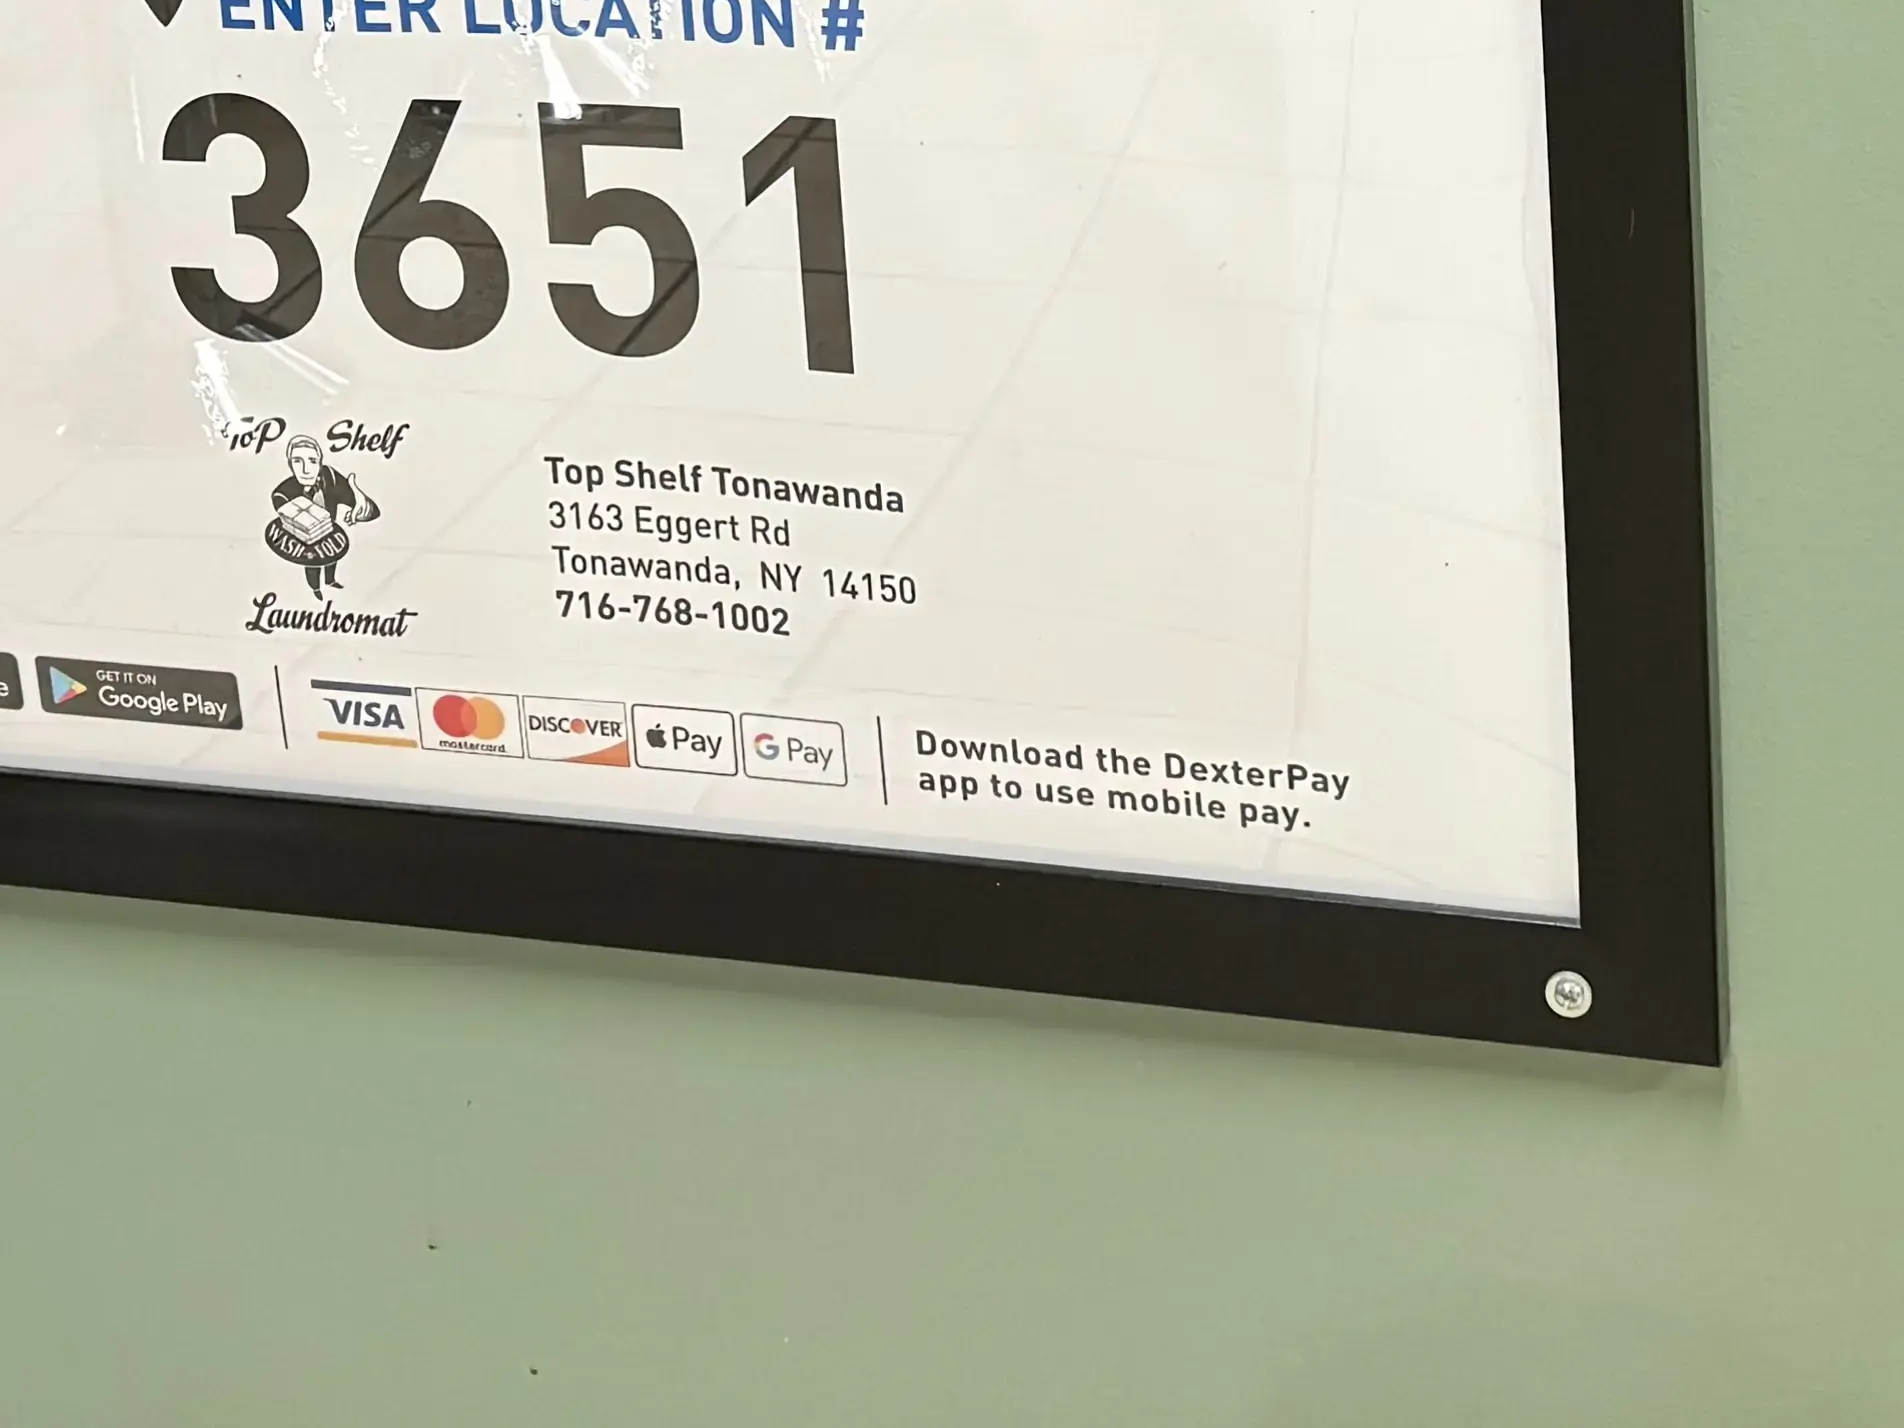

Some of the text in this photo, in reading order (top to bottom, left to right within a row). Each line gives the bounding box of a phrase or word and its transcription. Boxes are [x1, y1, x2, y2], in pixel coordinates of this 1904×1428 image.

[162, 92, 855, 374] 3651
[326, 419, 410, 459] Shelf
[544, 456, 904, 513] Top Shelf Tonawanda
[548, 500, 790, 546] 3163 Eggert Rd
[551, 545, 916, 604] Tonawanda, NY 14150
[245, 592, 418, 637] Laundromat
[555, 590, 790, 636] 716-768-1002
[96, 669, 156, 686] GET IT ON
[98, 685, 228, 723] Google Play
[323, 697, 405, 731] VISA
[439, 739, 507, 753] mastercard
[528, 715, 623, 738] DISCOVER
[672, 726, 722, 759] Pay
[787, 737, 833, 771] Pay
[916, 730, 1350, 800] Download the DexterPay
[919, 768, 1312, 831] app to use mobile pay.
